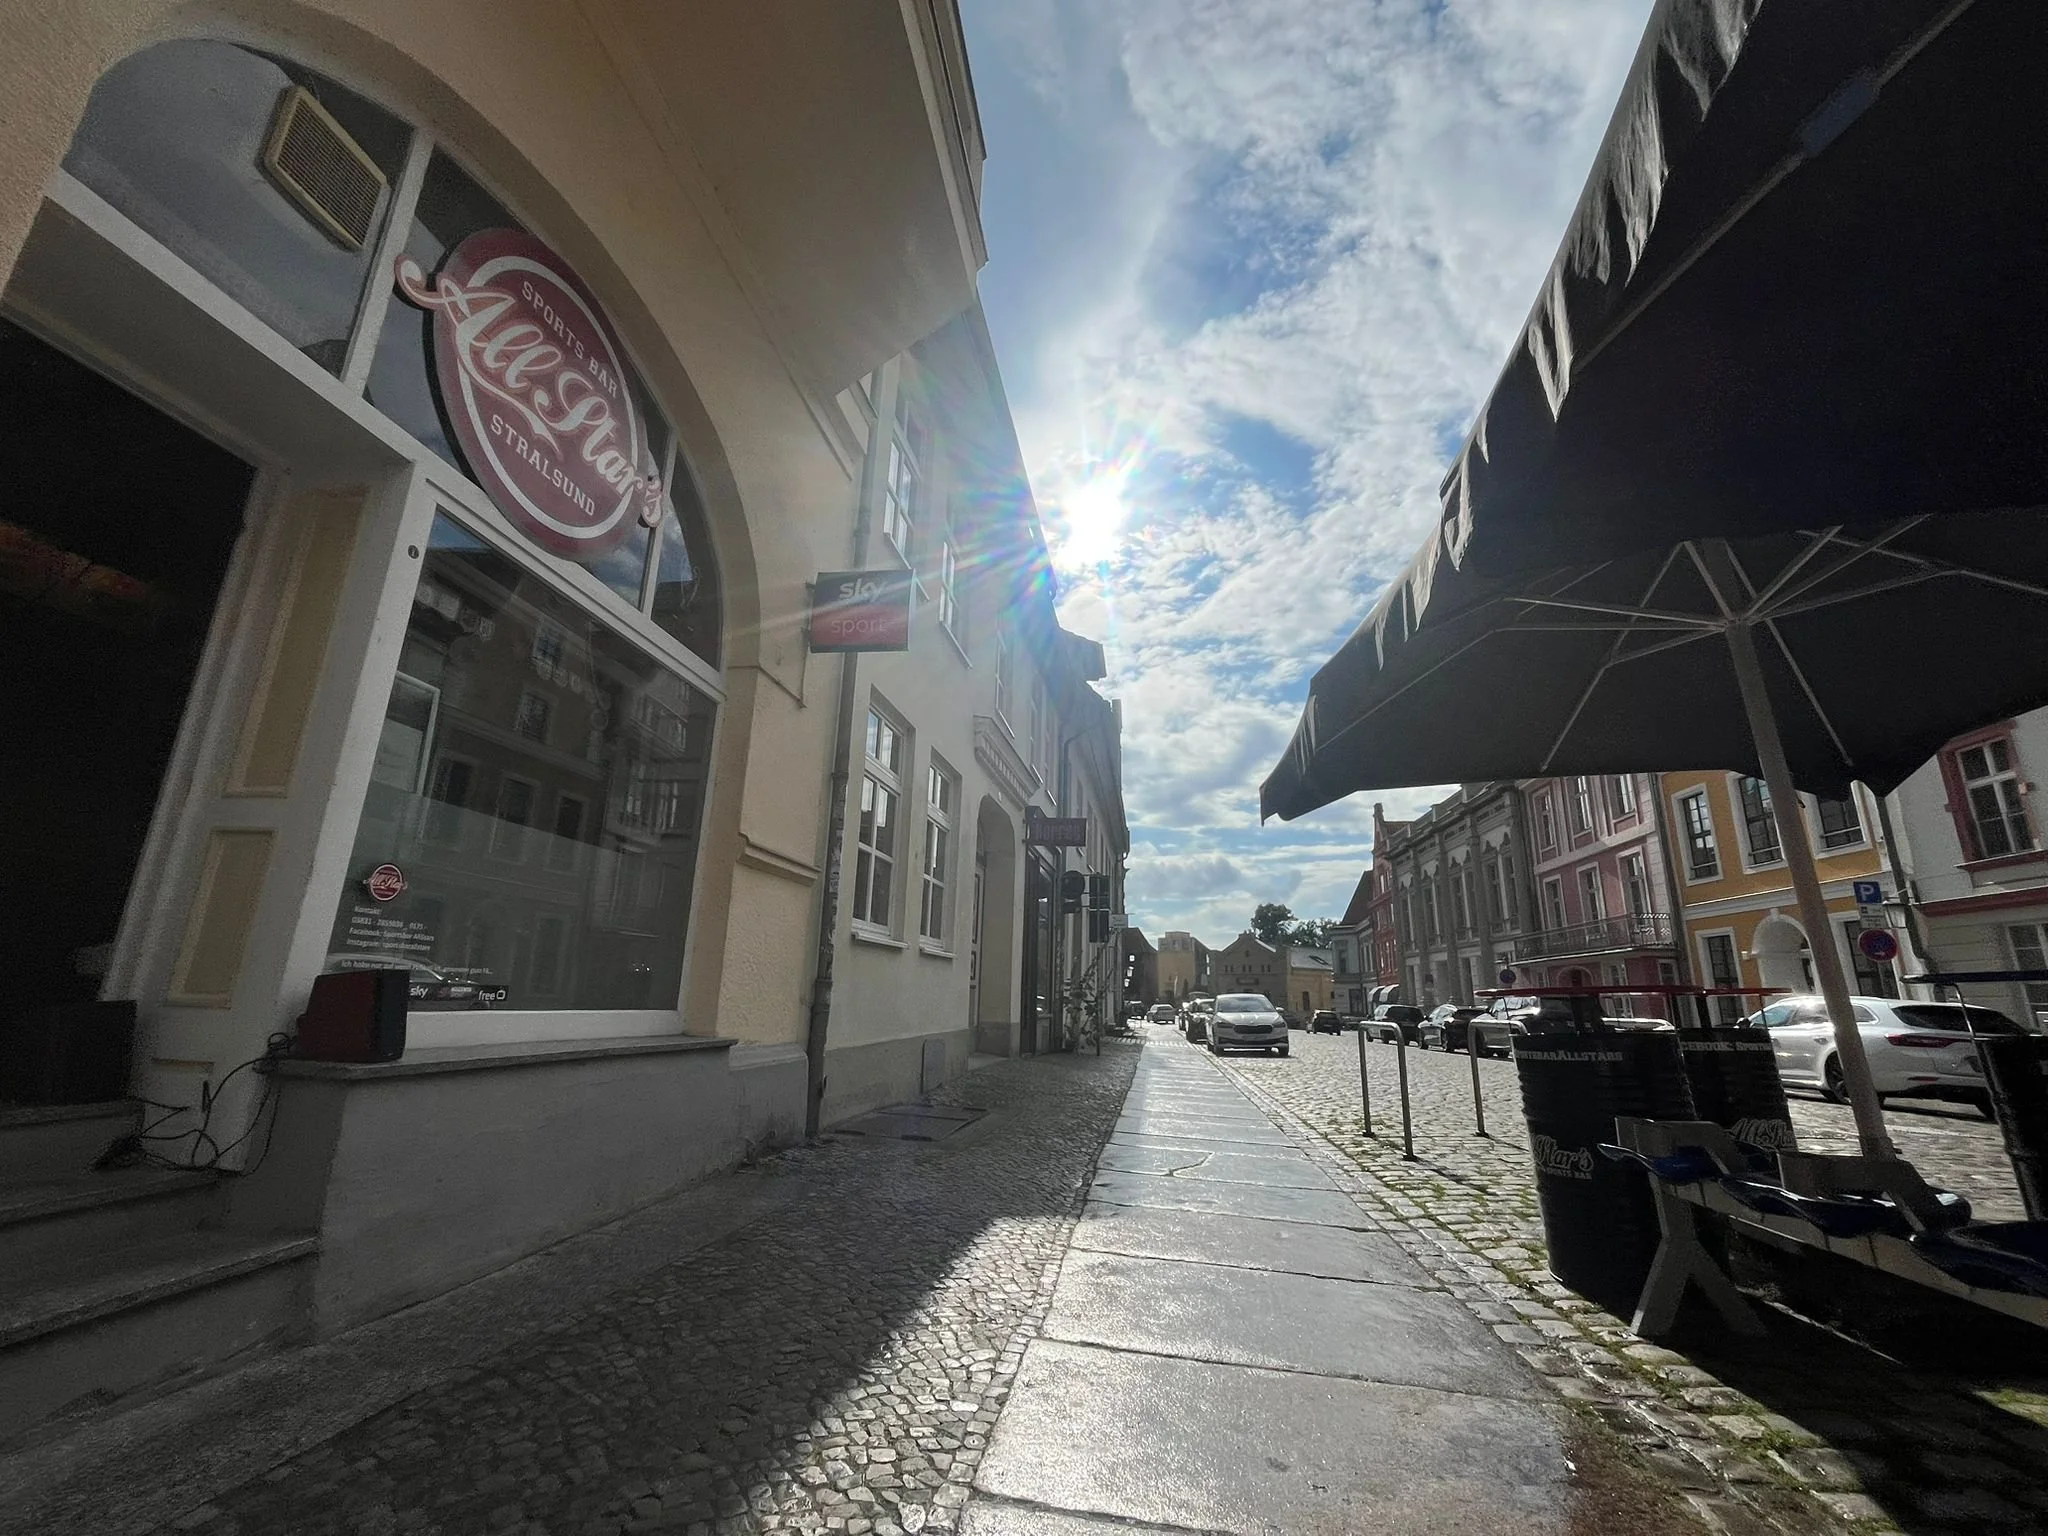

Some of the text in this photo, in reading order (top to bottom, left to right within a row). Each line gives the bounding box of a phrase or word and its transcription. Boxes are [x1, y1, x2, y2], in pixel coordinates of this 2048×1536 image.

[521, 280, 619, 399] SPORTS BAR
[490, 413, 597, 517] STRALSUND
[831, 617, 888, 638] sport
[1860, 884, 1874, 901] P
[409, 985, 429, 998] sky
[478, 990, 496, 1001] free
